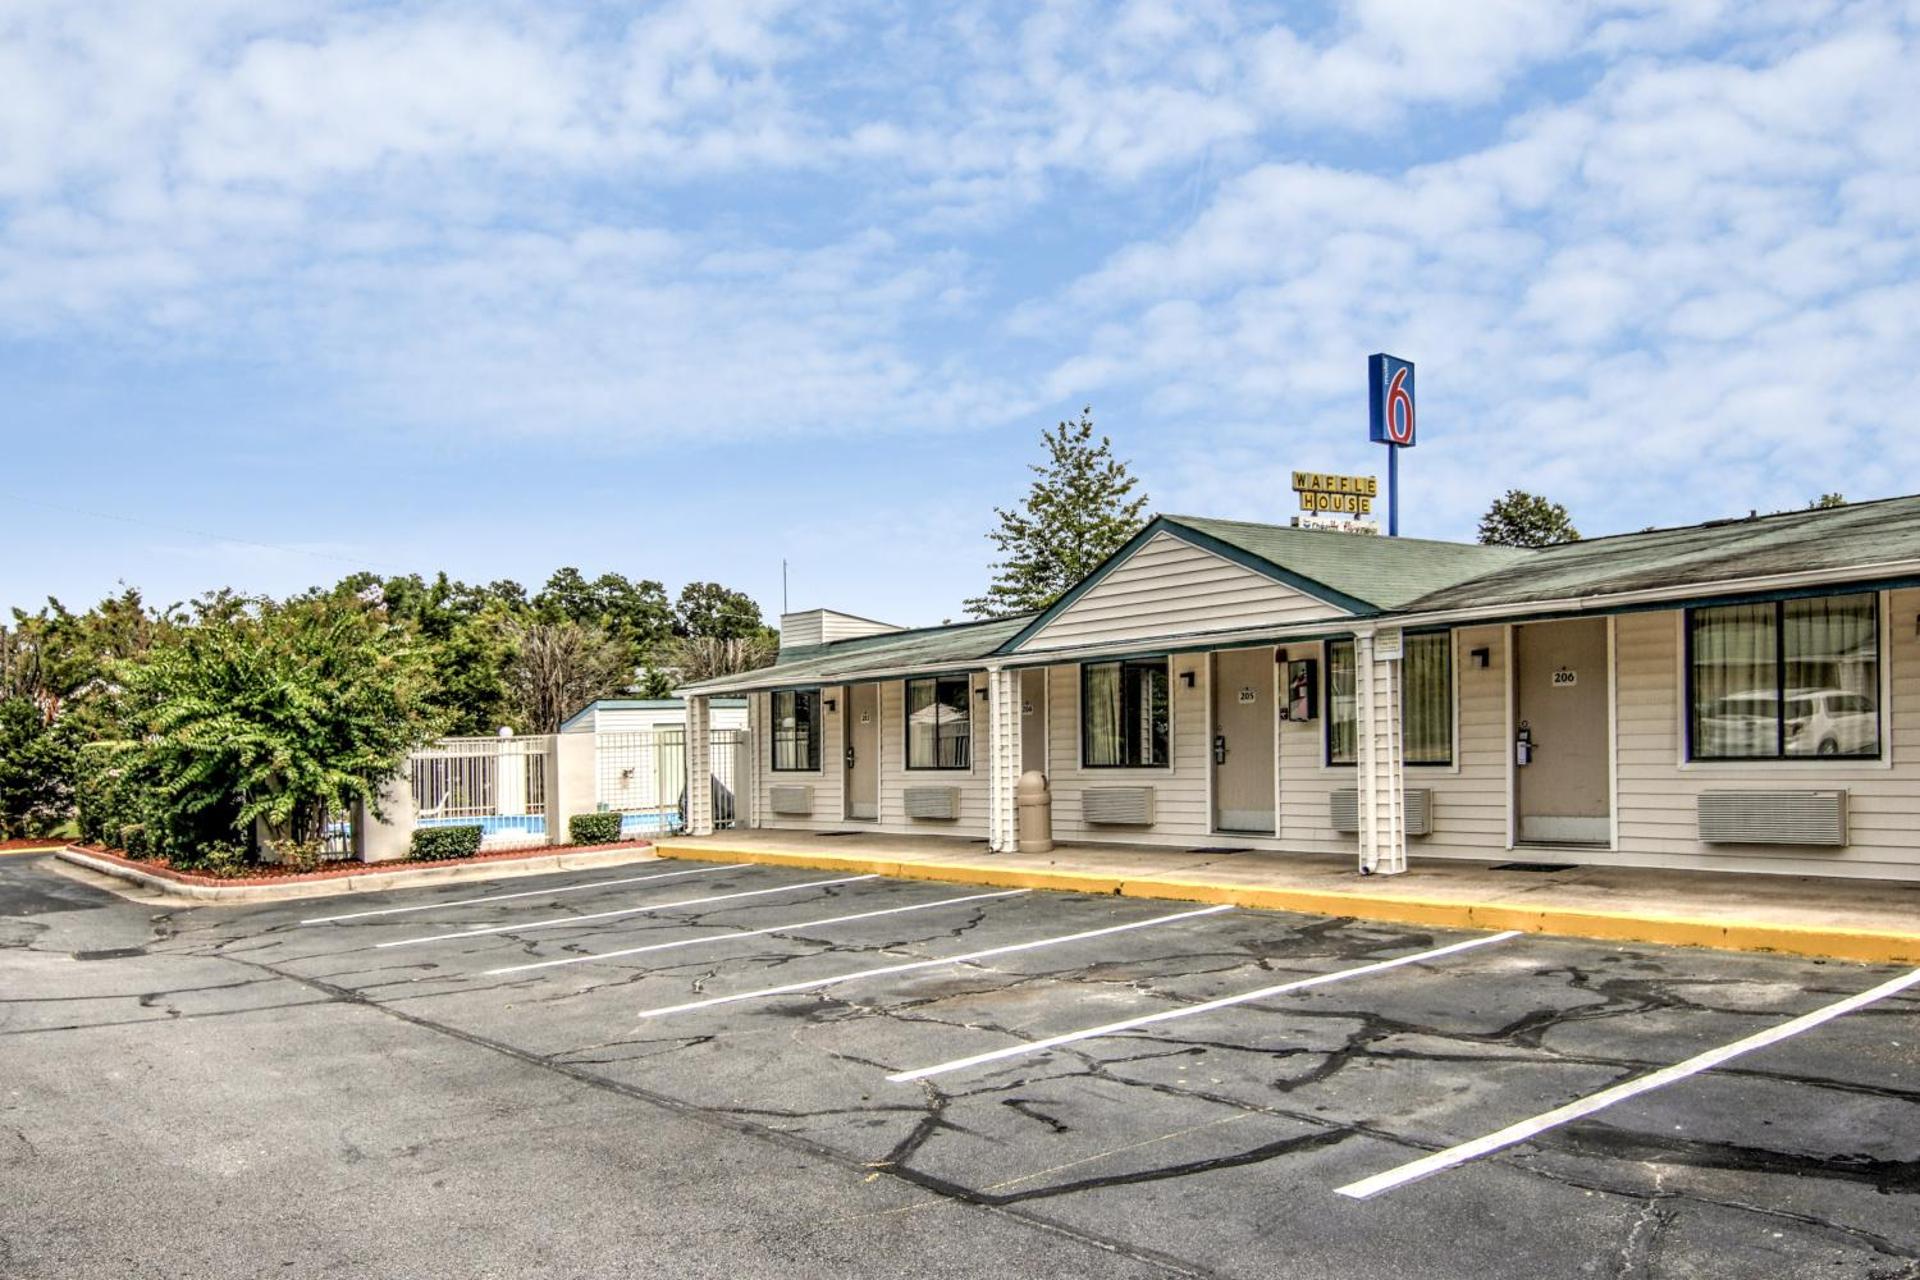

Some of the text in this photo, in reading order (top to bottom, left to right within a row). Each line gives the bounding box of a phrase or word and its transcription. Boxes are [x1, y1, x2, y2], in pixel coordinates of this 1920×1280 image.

[1386, 366, 1414, 444] 6
[1296, 473, 1376, 493] WAFFLE
[1304, 494, 1370, 512] HOUSE
[1554, 671, 1575, 683] 206
[1240, 691, 1255, 701] 205
